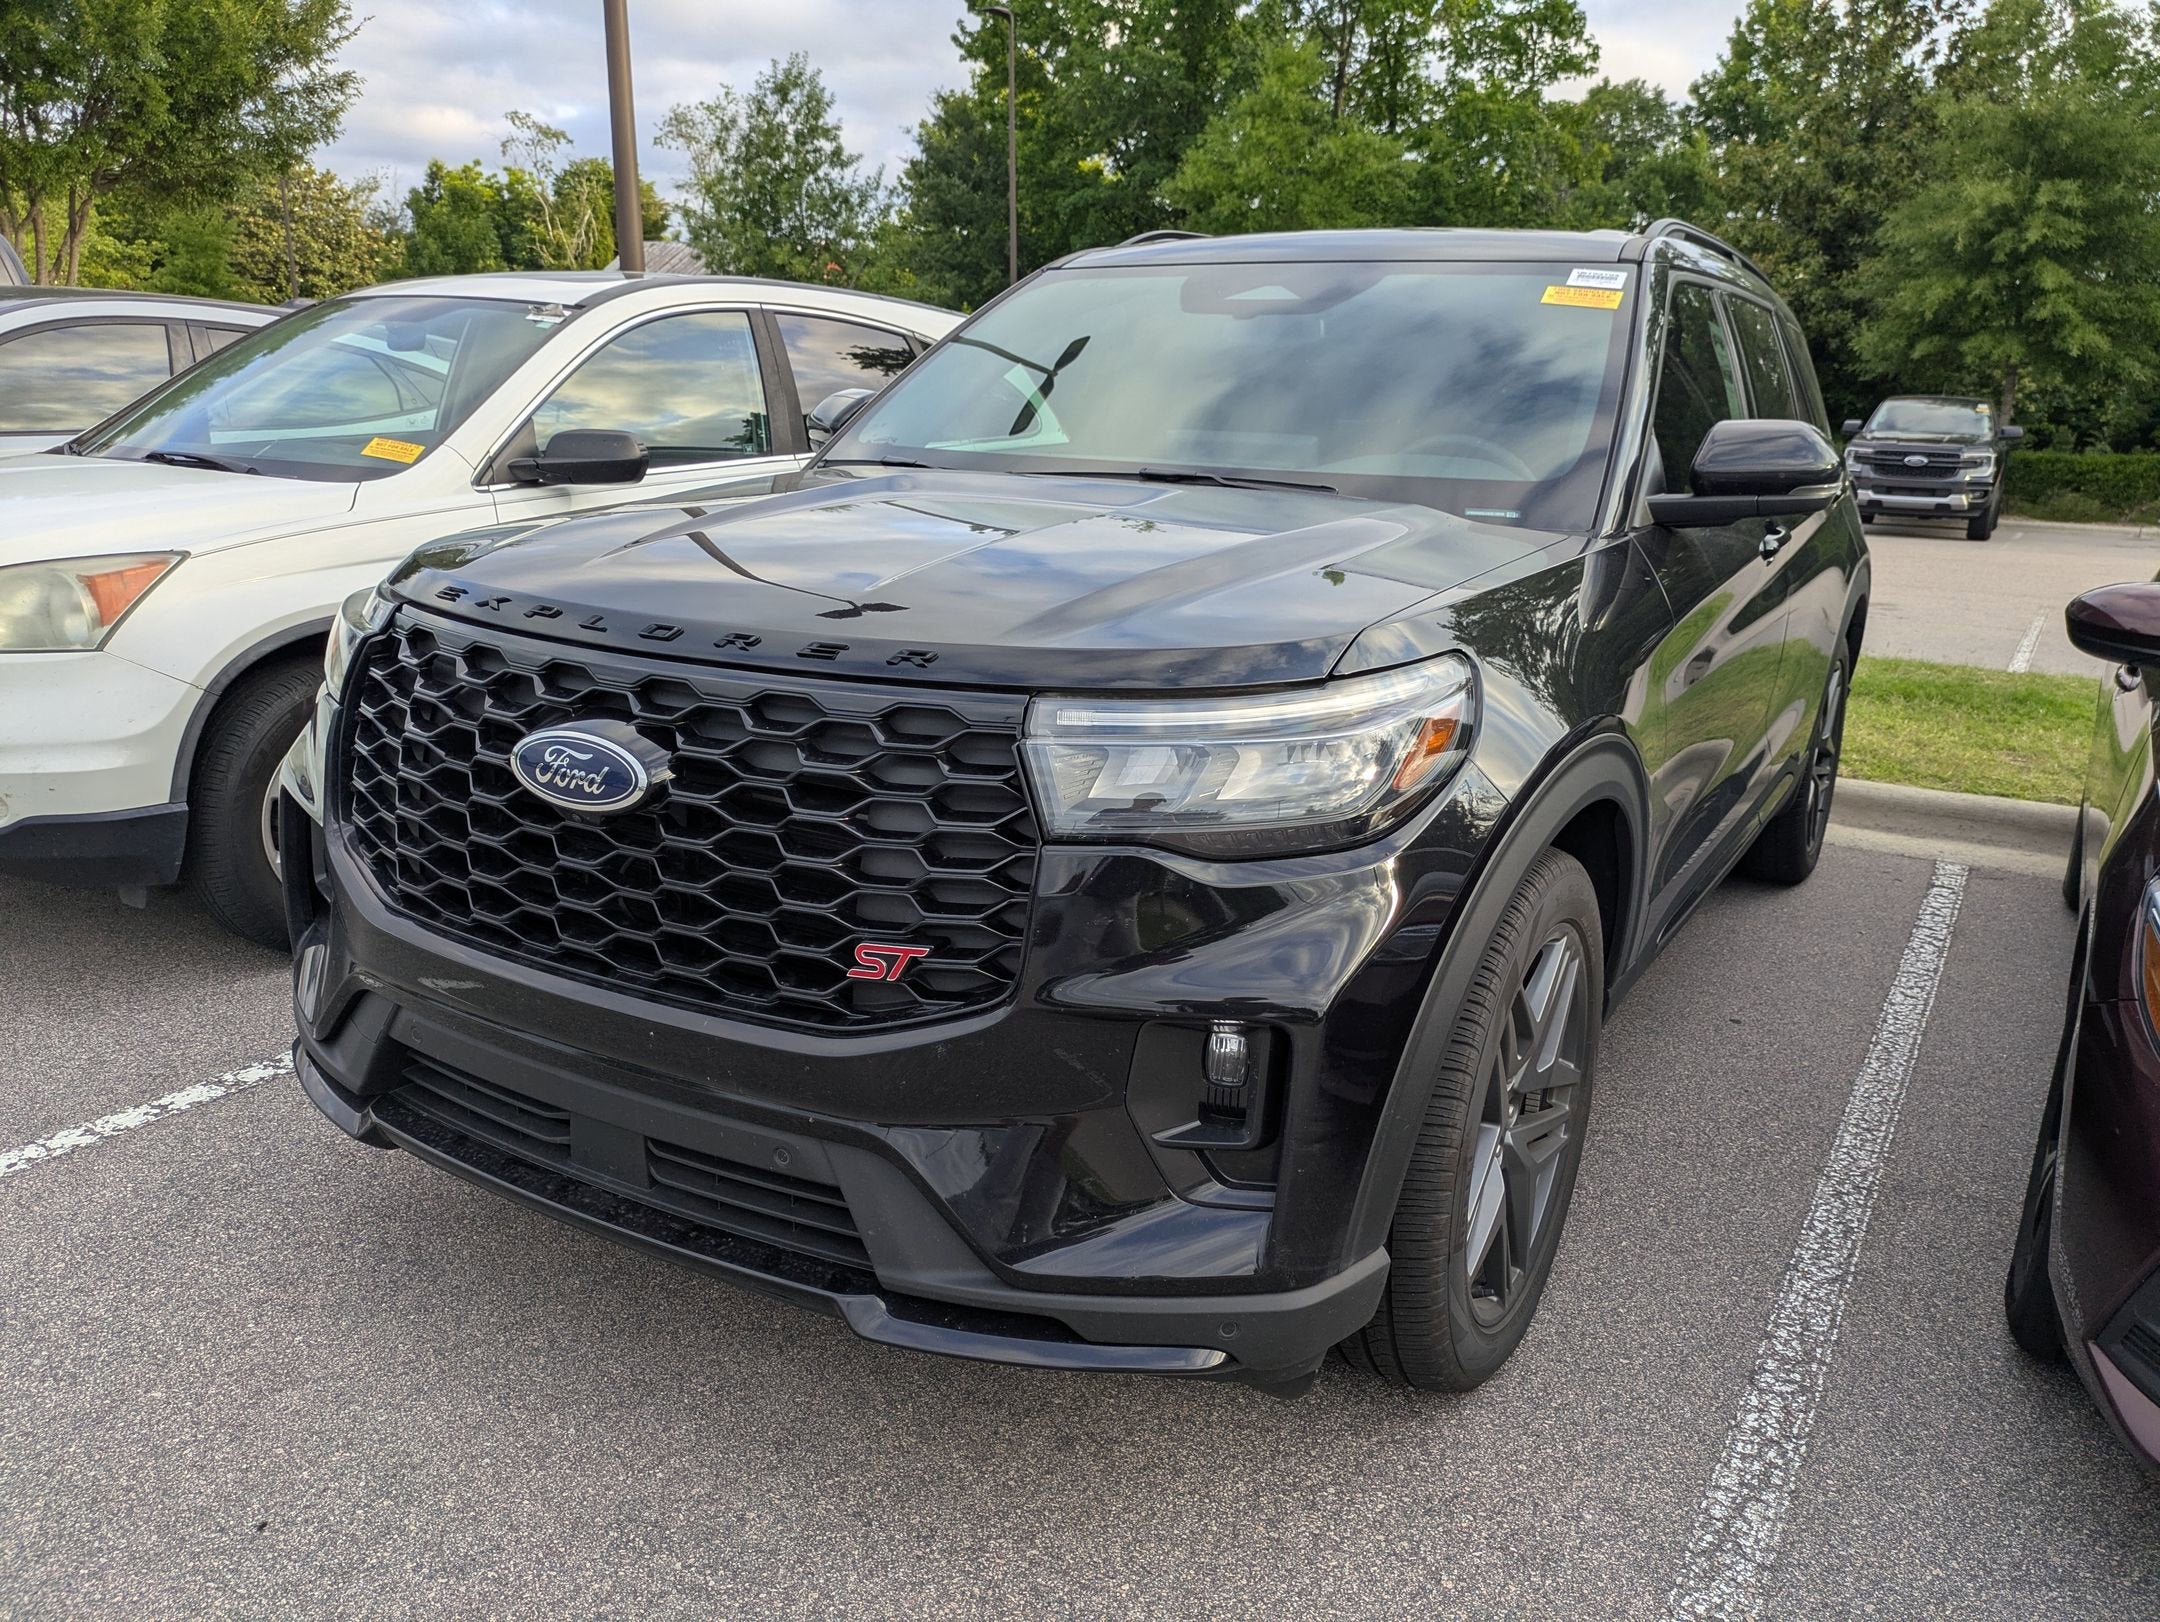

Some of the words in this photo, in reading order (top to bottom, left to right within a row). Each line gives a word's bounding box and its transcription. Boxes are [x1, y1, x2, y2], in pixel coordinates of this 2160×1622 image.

[434, 585, 940, 669] EXPLORER
[535, 745, 610, 795] Ford
[846, 942, 931, 981] ST
